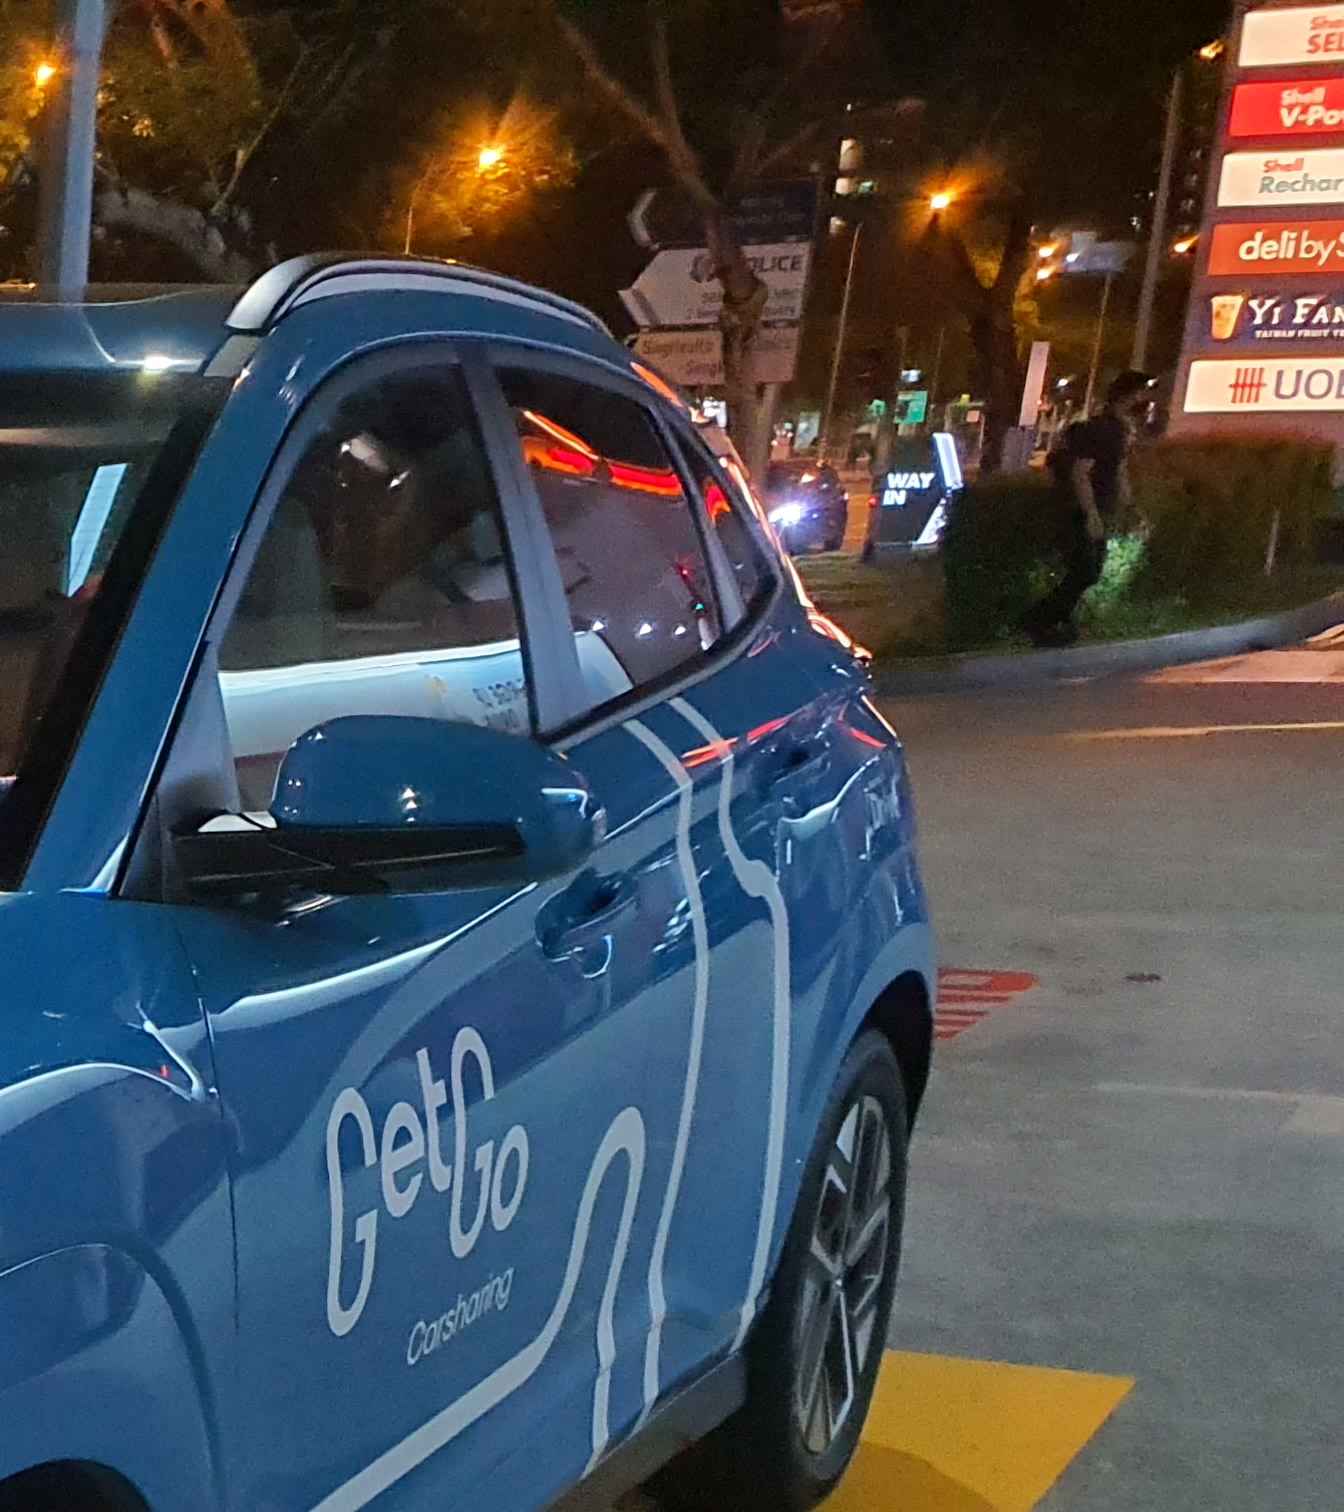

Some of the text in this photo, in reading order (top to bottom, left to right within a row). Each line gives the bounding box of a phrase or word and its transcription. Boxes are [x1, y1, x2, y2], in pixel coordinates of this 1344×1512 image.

[1307, 31, 1344, 54] SEL
[1280, 105, 1344, 128] V-Po
[1263, 157, 1305, 173] Shell
[1258, 172, 1344, 194] Rechar
[1238, 230, 1297, 260] deli
[887, 472, 935, 489] WAY
[881, 490, 907, 506] IN
[327, 1026, 529, 1336] GetGo
[407, 1267, 514, 1365] Carsharing
